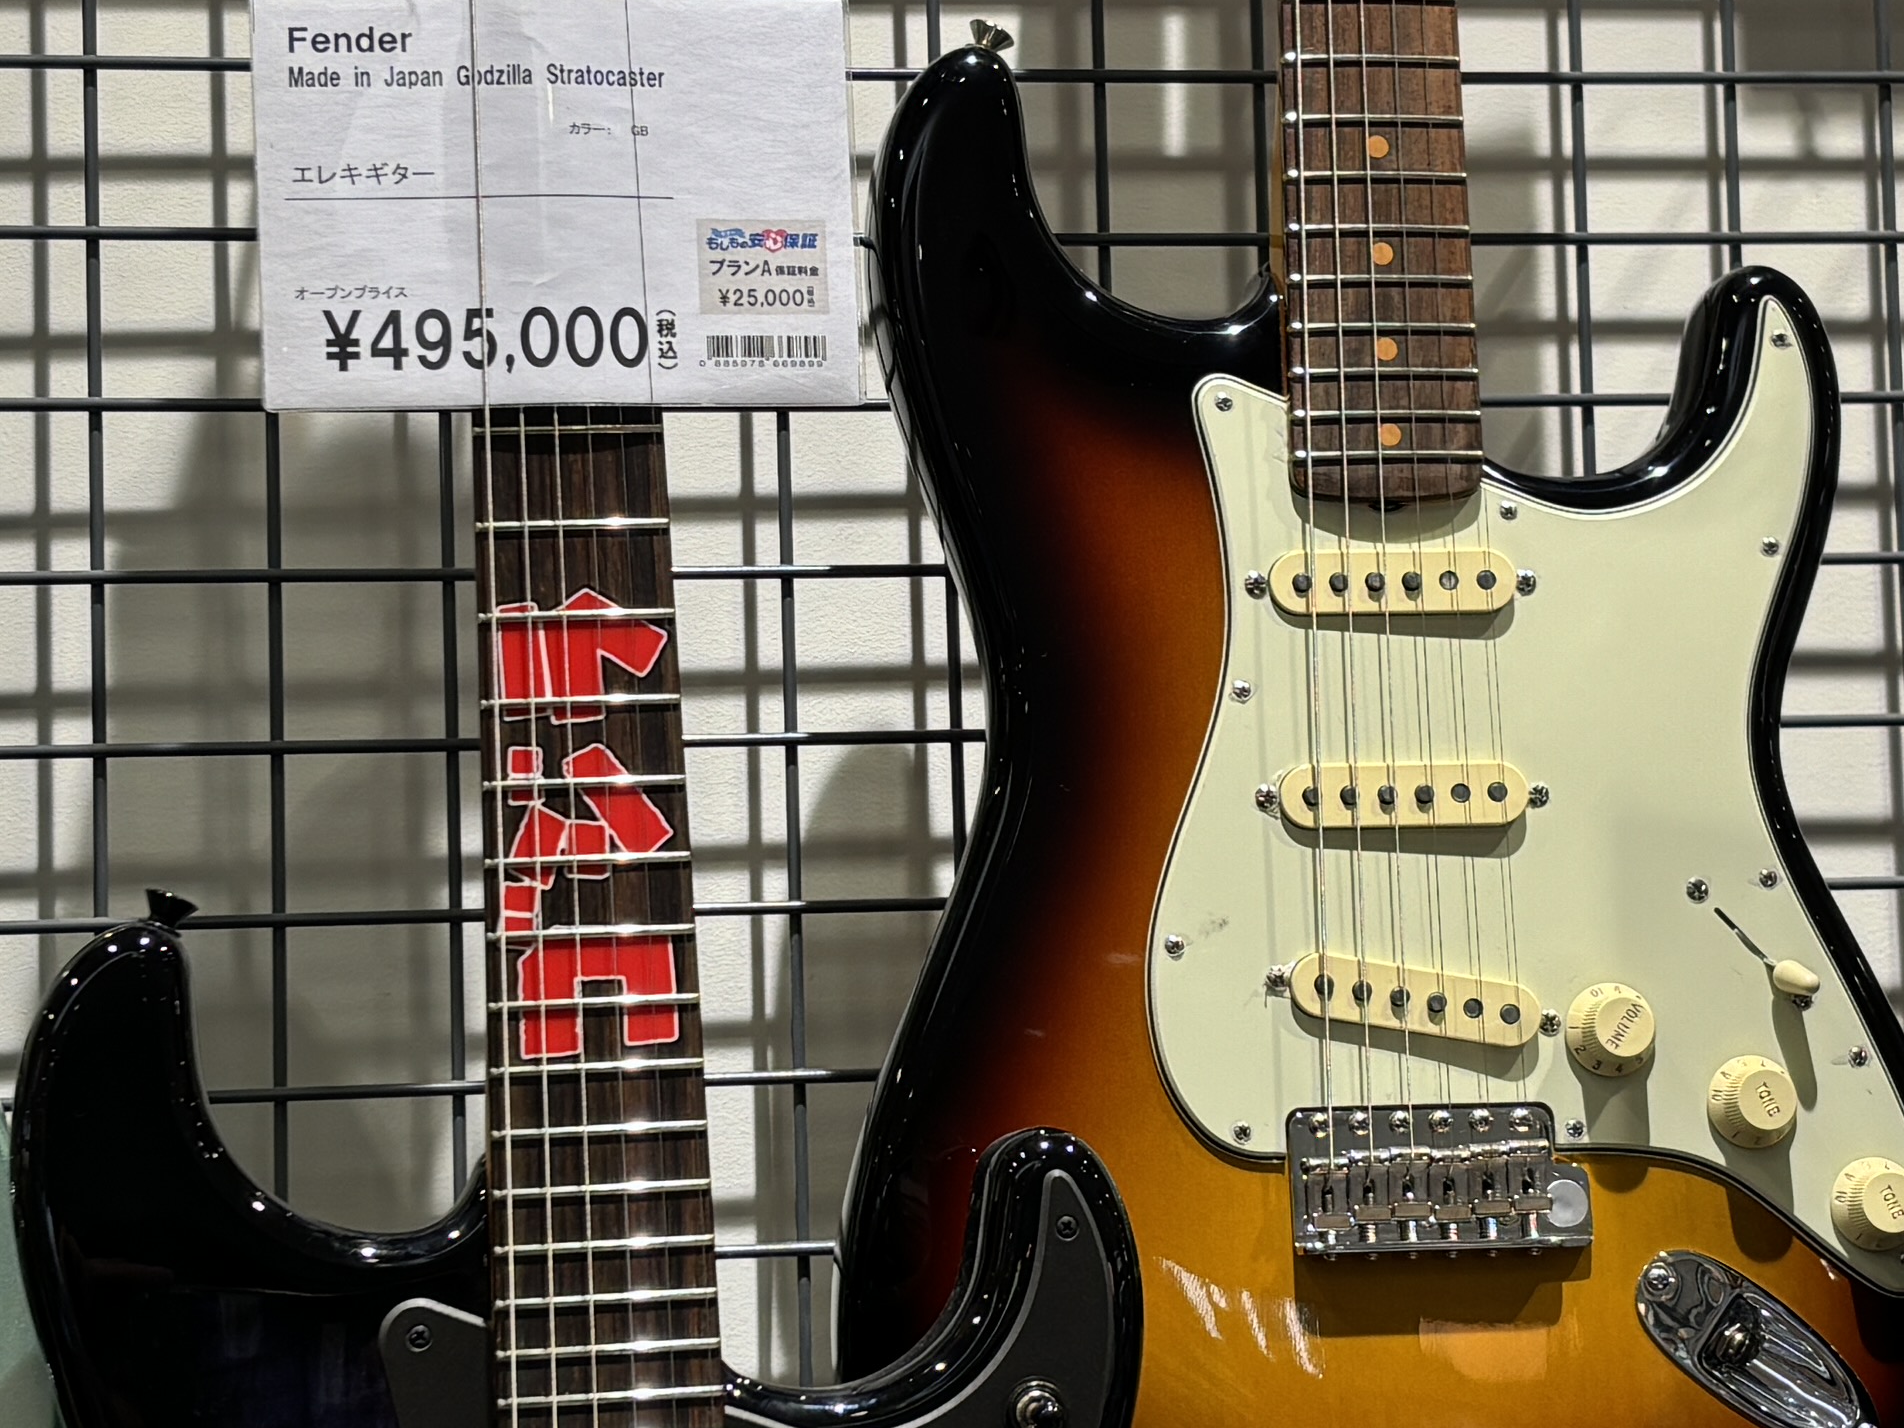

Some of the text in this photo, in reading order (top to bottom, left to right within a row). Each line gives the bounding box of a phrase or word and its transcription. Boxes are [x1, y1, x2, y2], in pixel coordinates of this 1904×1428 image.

[287, 27, 413, 55] Fender
[288, 64, 666, 90] Made in Japan Godzilla Stratocaster
[292, 163, 435, 186] エレキギター
[718, 288, 804, 307] ¥25,000
[323, 307, 648, 374] ¥495,000
